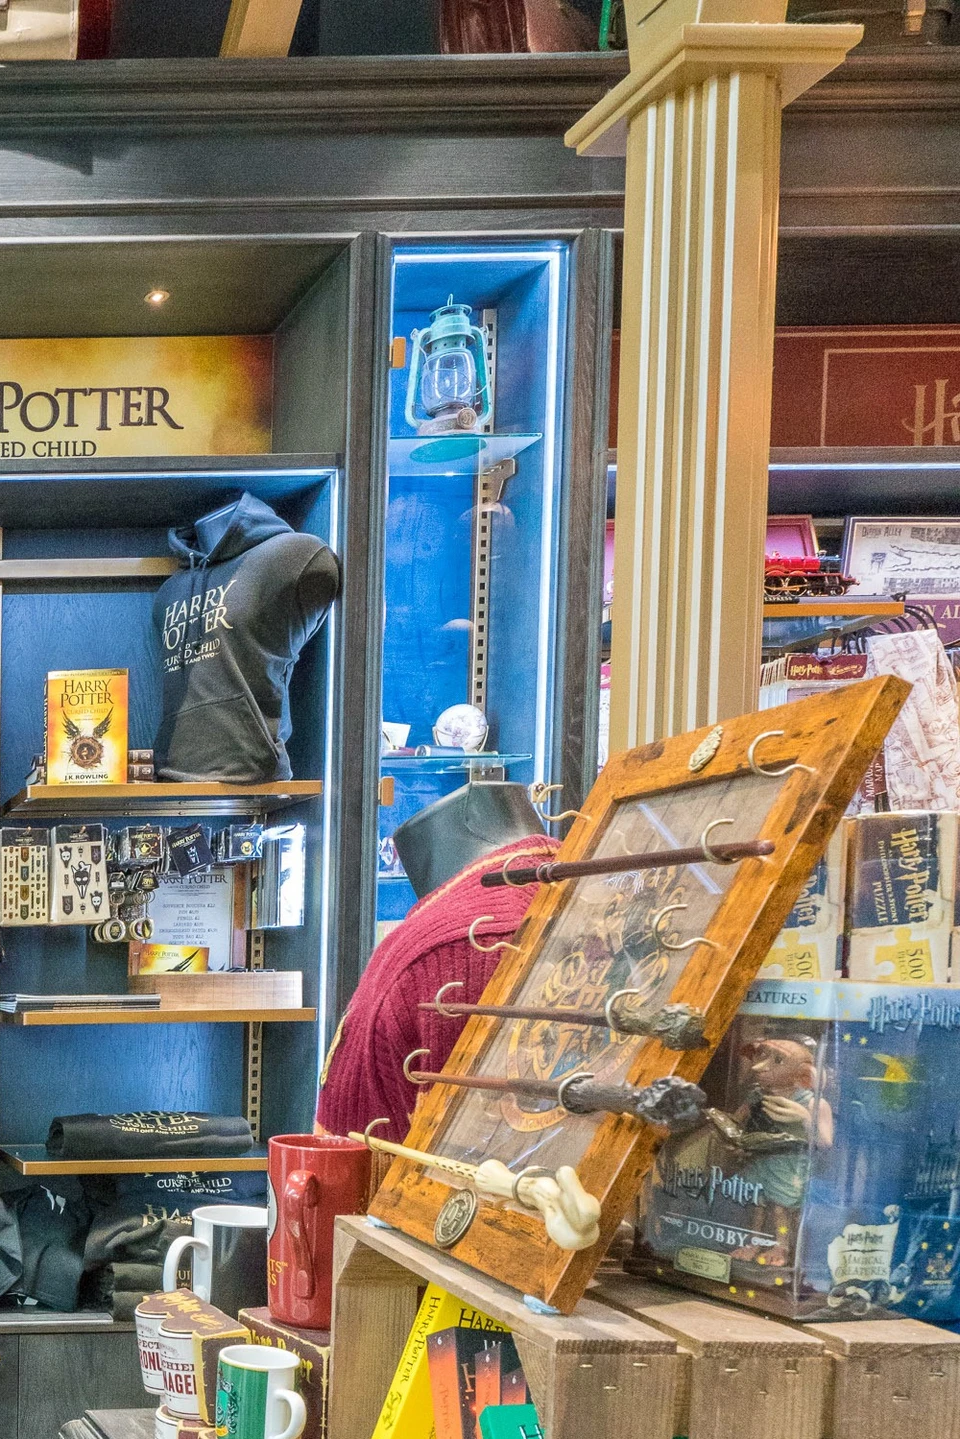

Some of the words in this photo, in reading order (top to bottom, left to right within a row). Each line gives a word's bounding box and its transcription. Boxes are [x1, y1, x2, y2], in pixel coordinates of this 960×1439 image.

[32, 440, 97, 458] CHILD
[163, 579, 238, 631] HARRY
[161, 606, 234, 651] OTER
[63, 678, 112, 694] HARRY
[60, 692, 114, 708] POTTER
[890, 827, 925, 874] Harry
[188, 874, 228, 884] POTTER
[872, 881, 889, 925] PUZZLE
[894, 869, 930, 923] Potter
[906, 947, 927, 980] 500
[109, 1118, 155, 1130] CURSED
[158, 1124, 199, 1133] CHILD
[708, 1164, 765, 1208] Potter
[687, 1220, 749, 1247] DOBBY
[834, 1265, 890, 1278] CREATURES
[418, 1296, 441, 1339] HARRY
[437, 1336, 443, 1346] 6
[401, 1338, 426, 1383] POTTER
[486, 1354, 491, 1363] 6
[512, 1376, 517, 1385] 6
